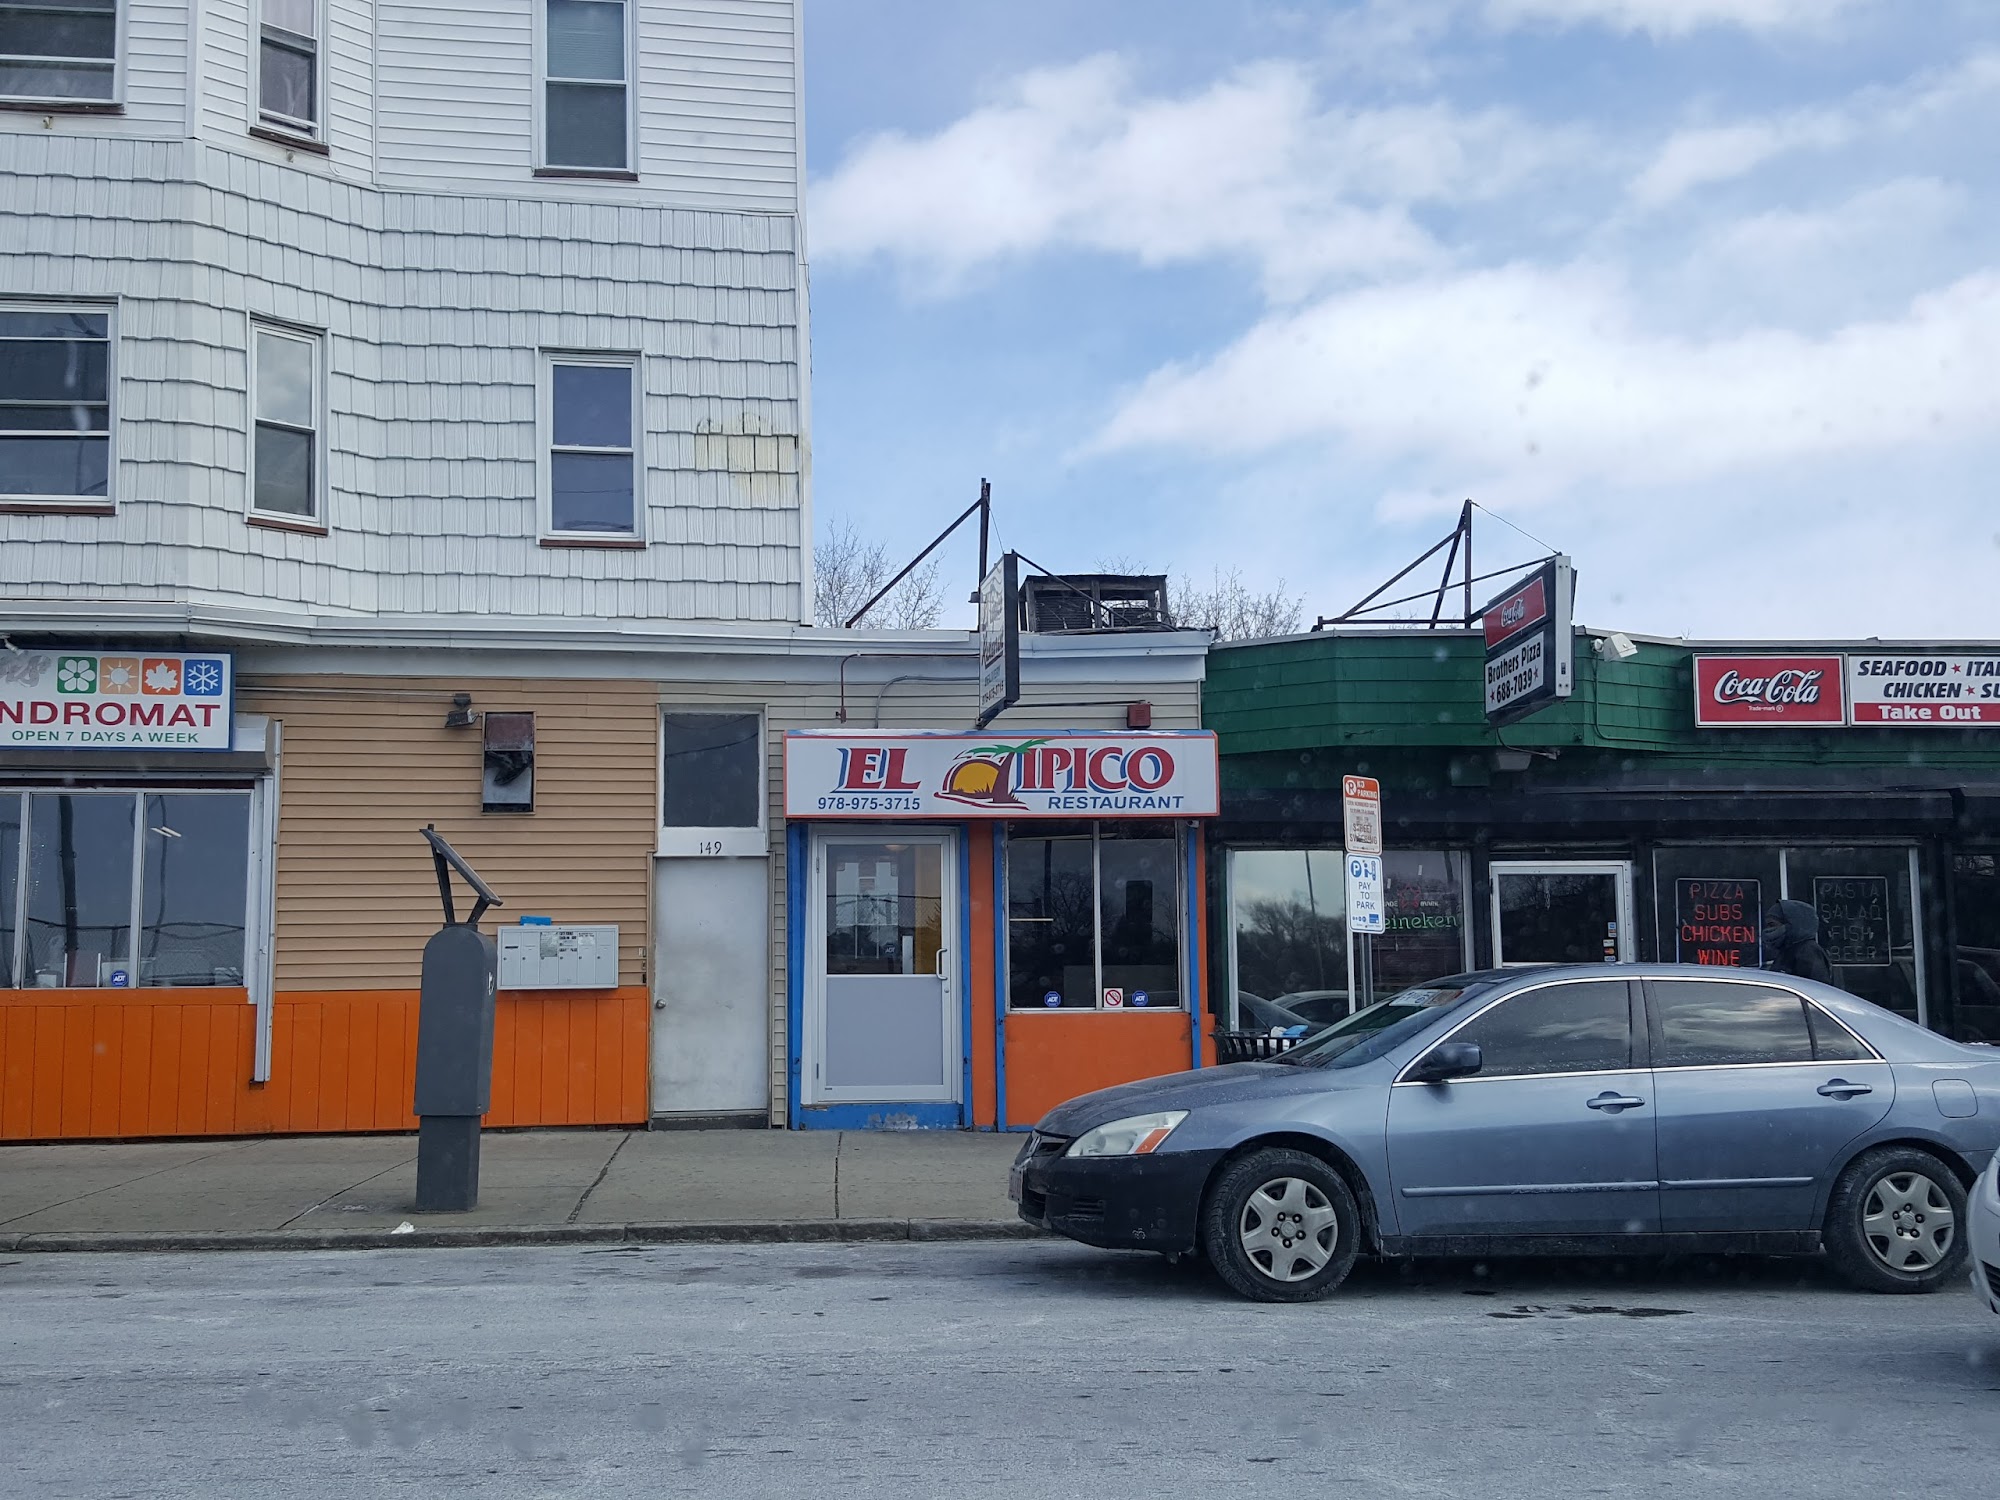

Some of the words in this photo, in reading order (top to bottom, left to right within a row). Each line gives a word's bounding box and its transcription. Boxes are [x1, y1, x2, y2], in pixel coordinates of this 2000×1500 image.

[1487, 654, 1520, 685] Brothers
[1521, 641, 1541, 667] Pizza
[1857, 660, 1947, 677] SEAFOOD
[1496, 667, 1533, 703] 688-7039
[1713, 669, 1823, 705] Coca-Cola
[1883, 682, 1962, 698] CHICKEN
[0, 700, 221, 728] NDROMAT
[1878, 705, 1932, 720] Take
[1940, 705, 1981, 720] Out
[12, 730, 60, 741] OPEN
[65, 731, 75, 742] 7
[81, 731, 126, 742] DAYS
[131, 732, 143, 743] A
[148, 732, 199, 744] WEEK
[834, 746, 922, 794] EL
[818, 796, 921, 811] 978-975-3715
[1048, 795, 1185, 810] RESTAURANT
[700, 841, 722, 855] 149
[1358, 881, 1371, 891] PAY
[1689, 882, 1744, 900] PIZZA
[1821, 882, 1880, 899] PASTA
[1360, 891, 1370, 900] TO
[1356, 900, 1376, 911] PARK
[1694, 903, 1743, 921] SUBS
[1821, 903, 1883, 921] SALAD
[1385, 911, 1458, 930] eineken
[1681, 925, 1756, 944] CHICKEN
[1830, 925, 1874, 941] FISH
[1697, 948, 1741, 967] WINE
